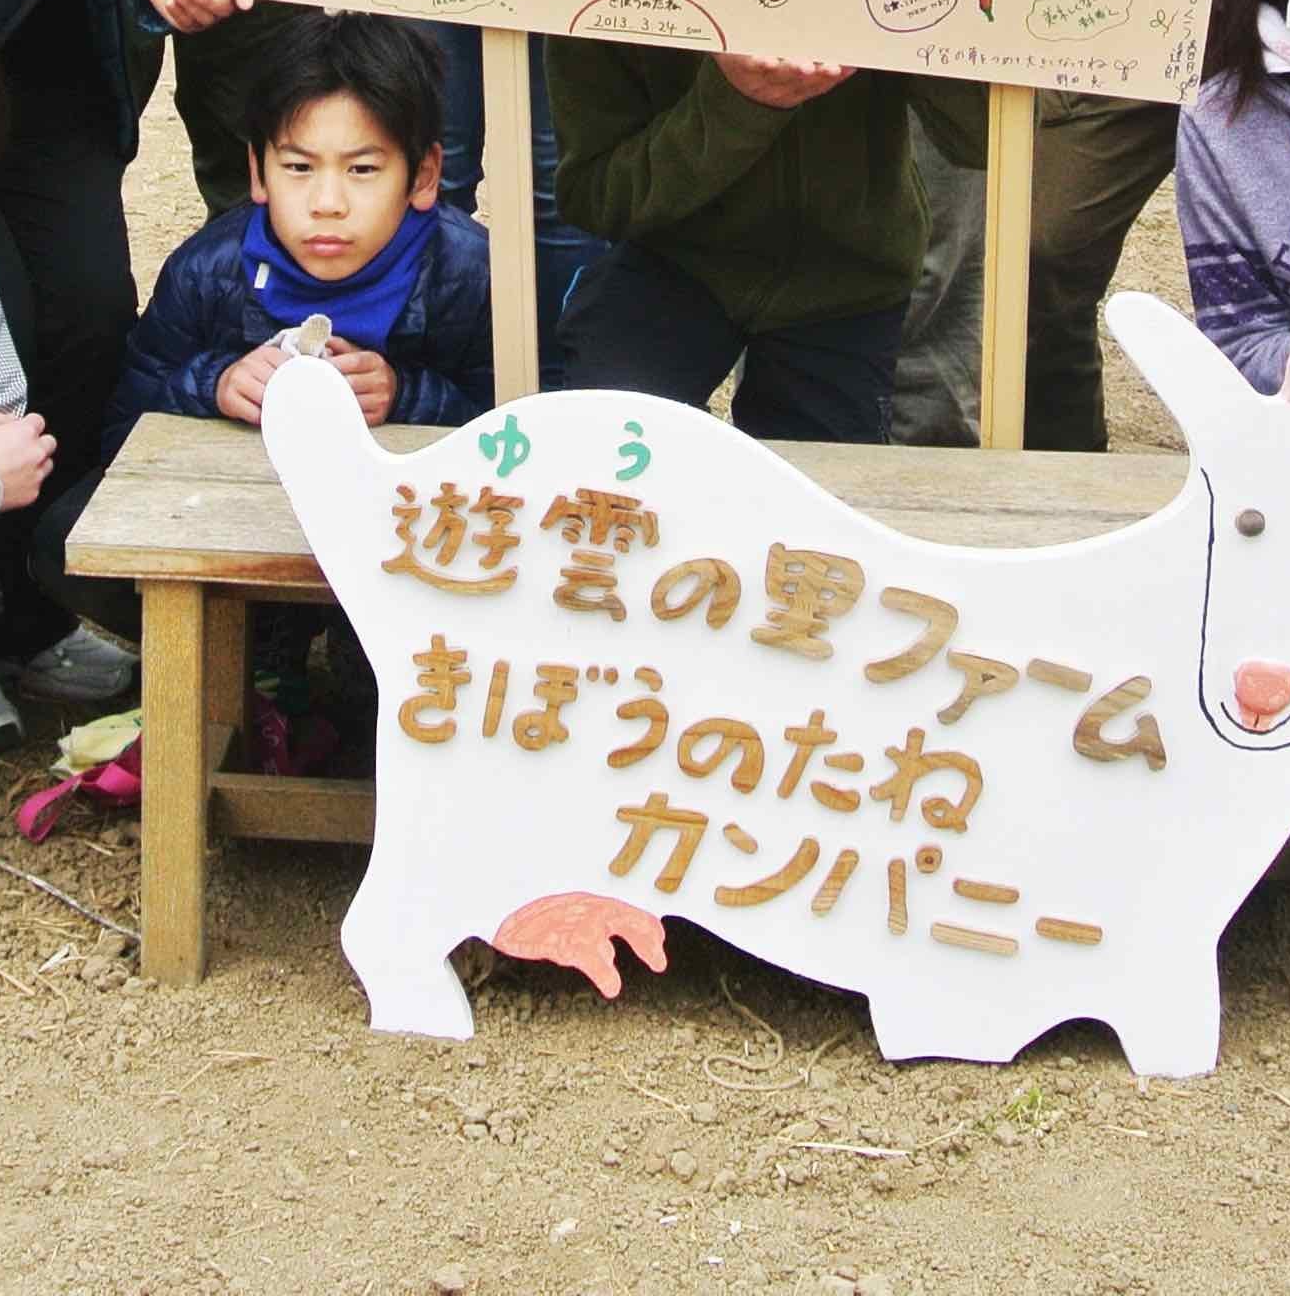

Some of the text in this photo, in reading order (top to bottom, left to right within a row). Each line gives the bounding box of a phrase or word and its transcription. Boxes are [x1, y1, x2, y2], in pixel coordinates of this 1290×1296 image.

[381, 481, 1167, 771] 遊雲の里ファーム
[397, 633, 985, 835] きぼうのたね
[608, 791, 1103, 956] カンパニー
